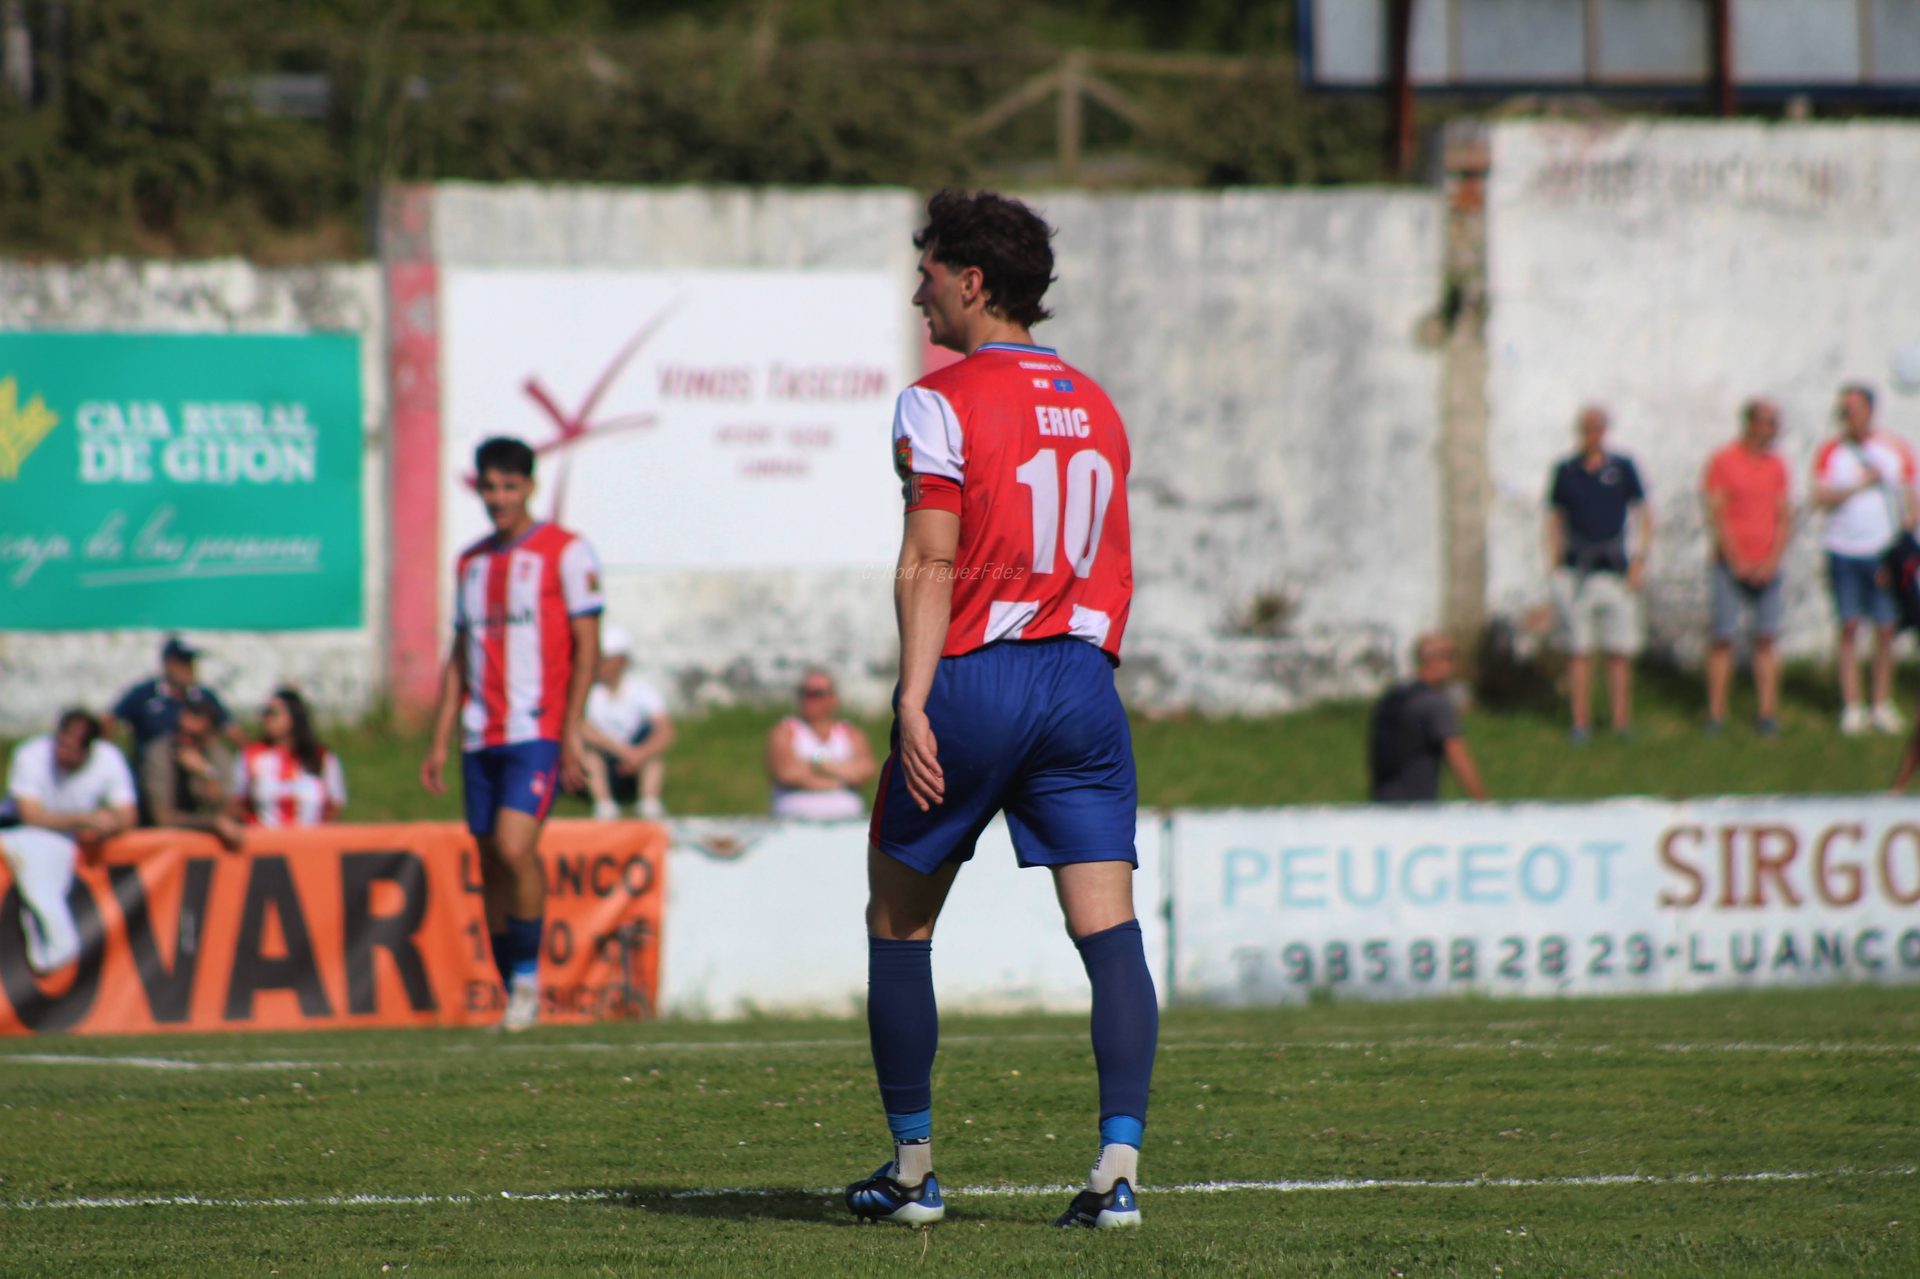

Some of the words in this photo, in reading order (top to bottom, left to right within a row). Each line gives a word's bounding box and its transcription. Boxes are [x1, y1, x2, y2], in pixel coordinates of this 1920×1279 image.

[1034, 405, 1091, 438] ERIC
[79, 438, 153, 483] DE
[1016, 448, 1113, 579] 10
[1221, 842, 1626, 909] PEUGEOT
